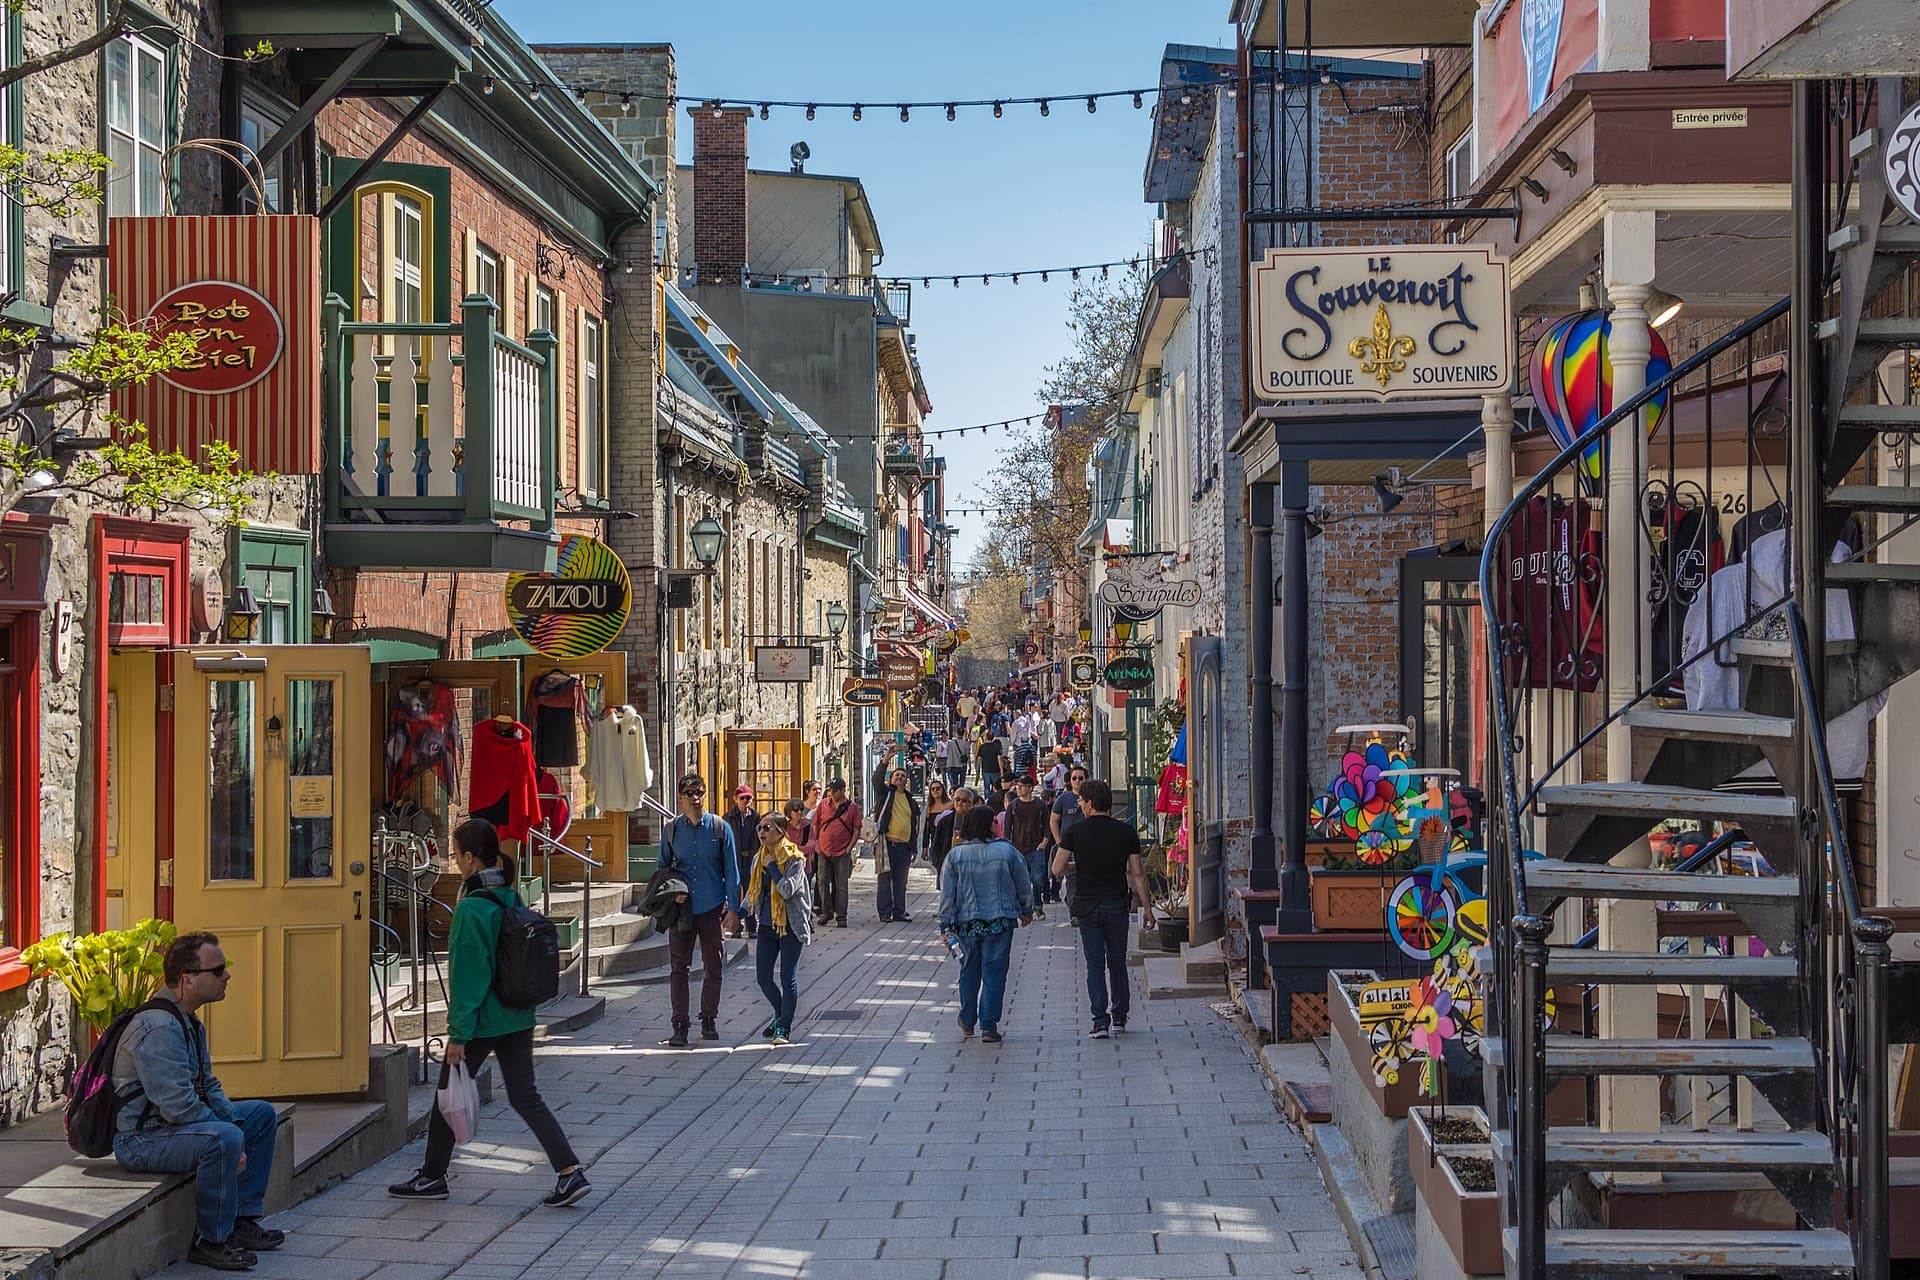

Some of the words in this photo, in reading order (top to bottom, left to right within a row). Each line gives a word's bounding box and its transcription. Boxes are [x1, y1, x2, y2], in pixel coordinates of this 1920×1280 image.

[1676, 112, 1709, 123] Entrée
[1712, 111, 1744, 124] privée
[1368, 257, 1391, 272] LE
[174, 298, 250, 321] Pot
[189, 327, 245, 341] en
[1270, 369, 1354, 388] BOUTIQUE
[1413, 365, 1498, 384] SOUVENIRS
[1721, 493, 1746, 514] 26
[526, 584, 608, 609] ZAZOU
[1102, 582, 1198, 608] Scrupules
[1391, 1003, 1415, 1011] SCHOO
